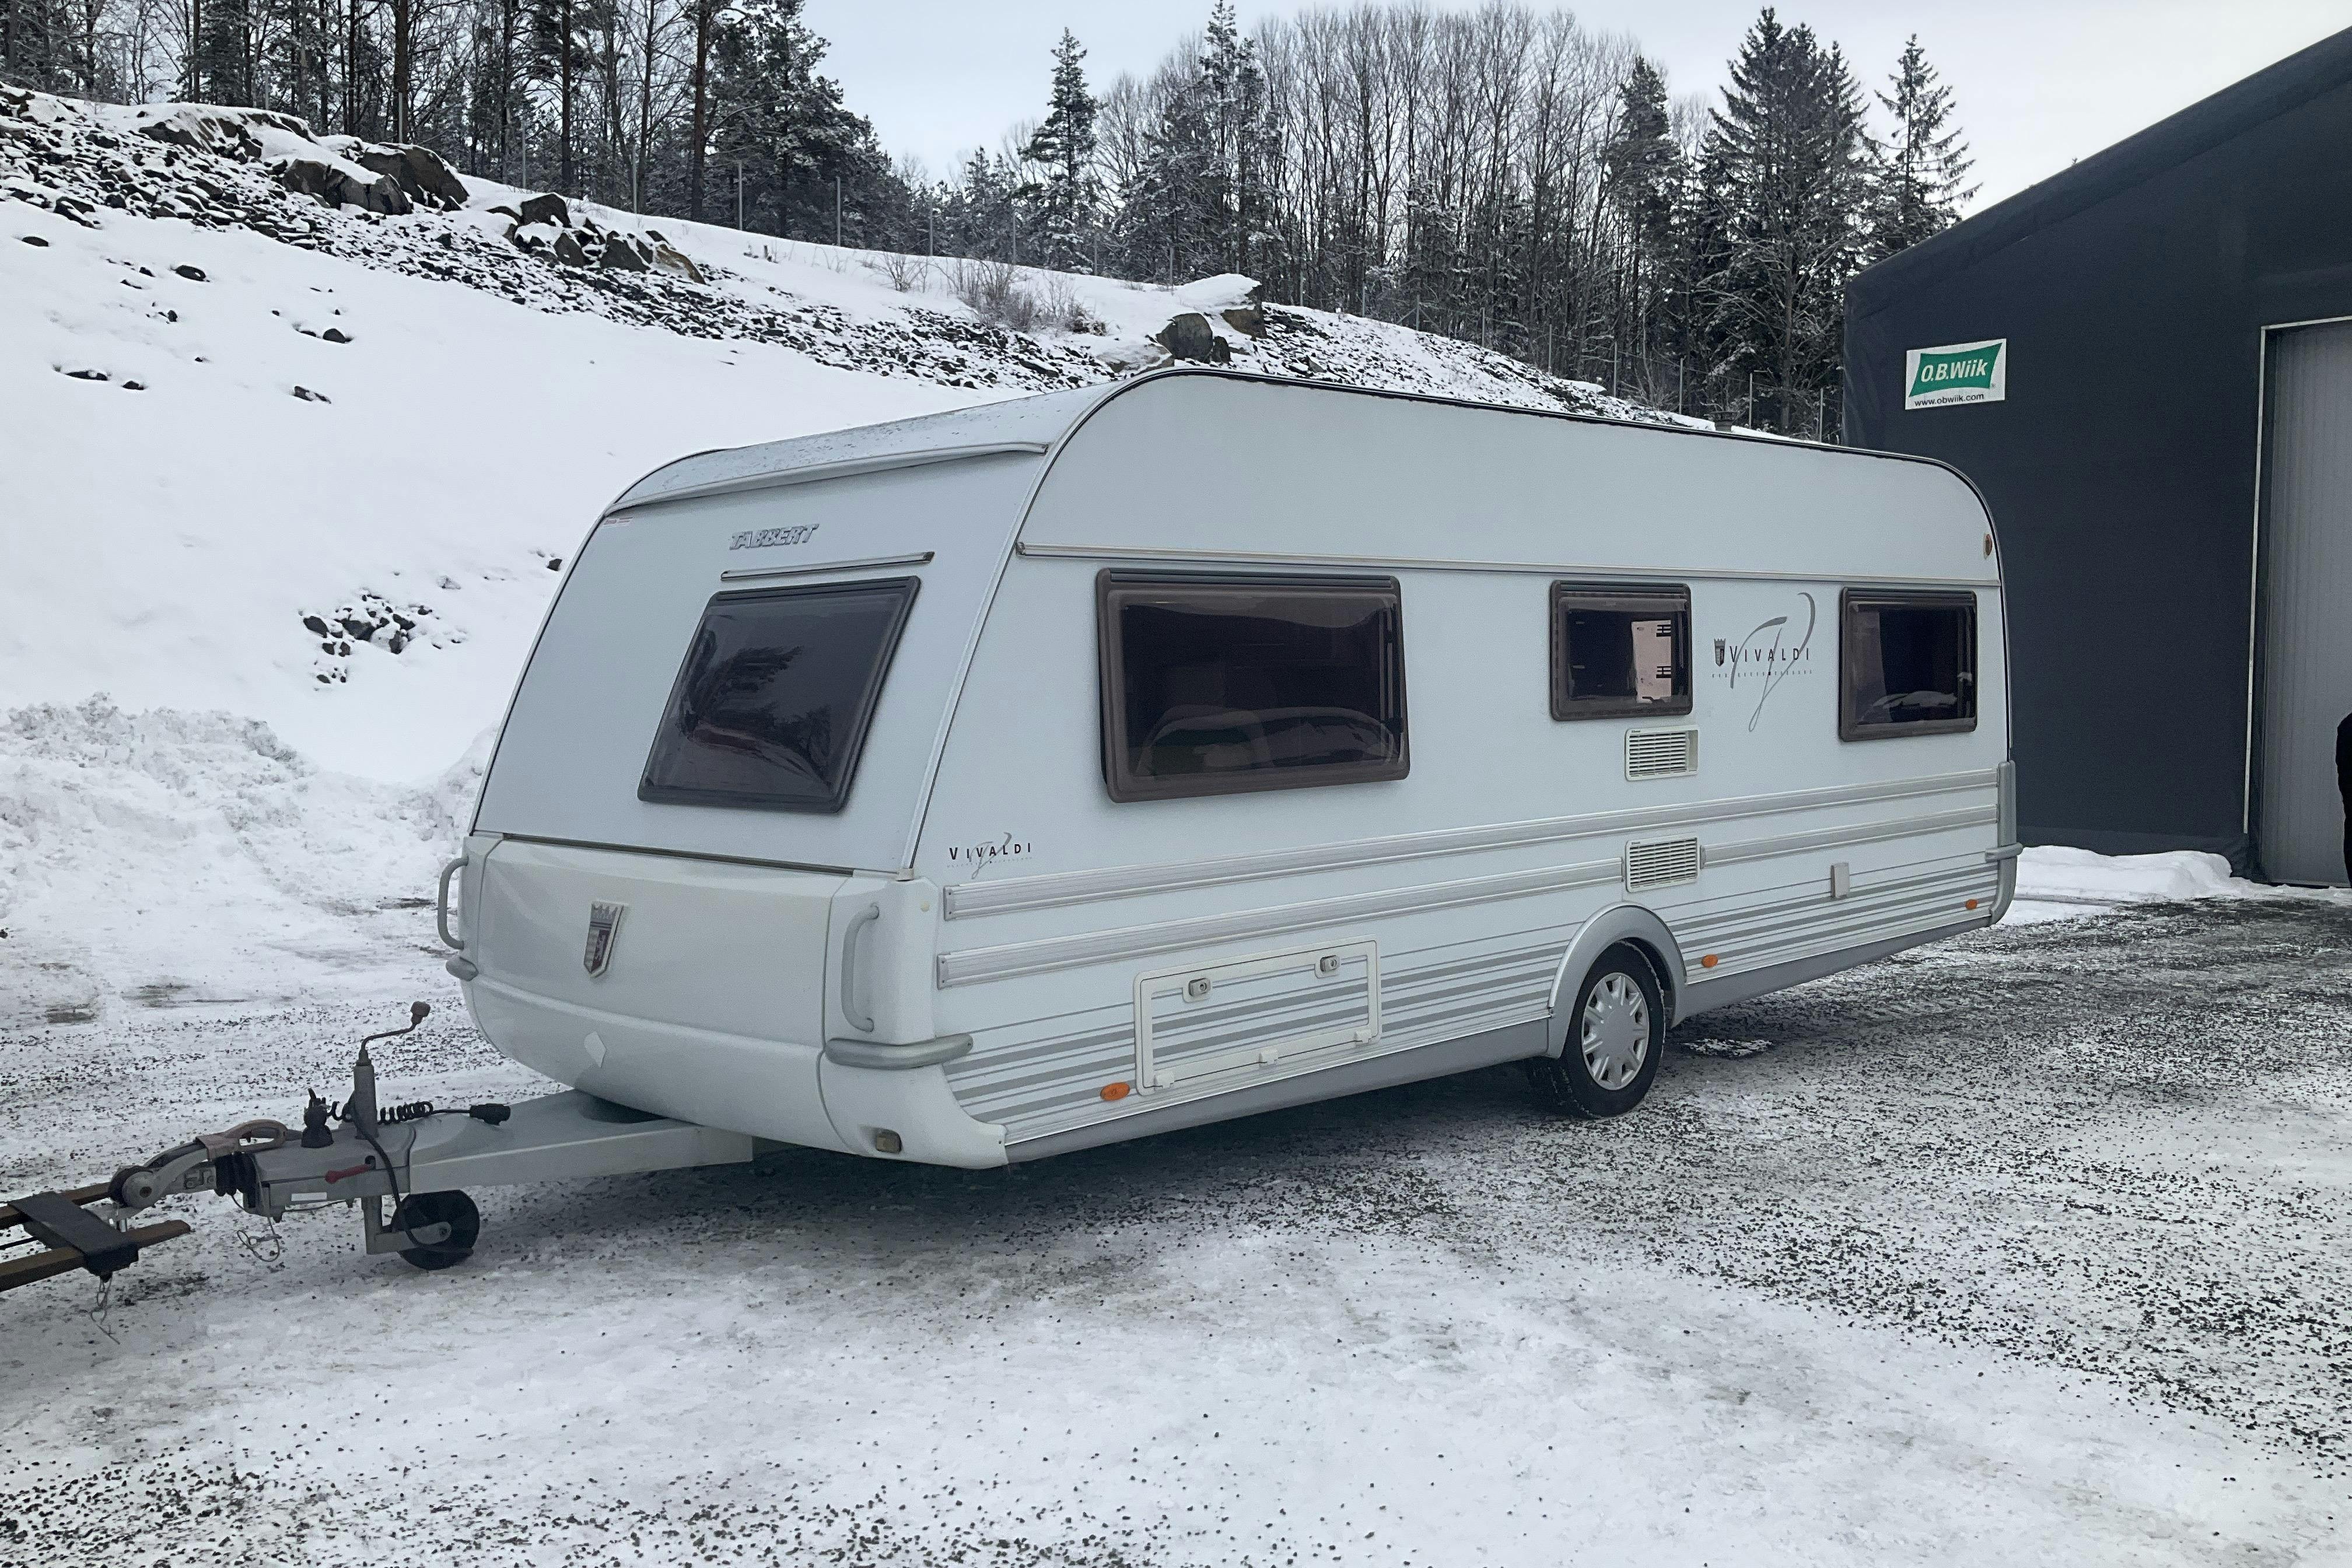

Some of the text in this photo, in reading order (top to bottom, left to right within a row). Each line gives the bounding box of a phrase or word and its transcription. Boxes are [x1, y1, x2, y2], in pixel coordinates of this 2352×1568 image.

[1915, 393, 1984, 406] www.obwiik.com
[729, 524, 820, 550] TABBERT
[1730, 646, 1809, 662] VIVALDI
[949, 843, 1031, 860] VIVALDI
